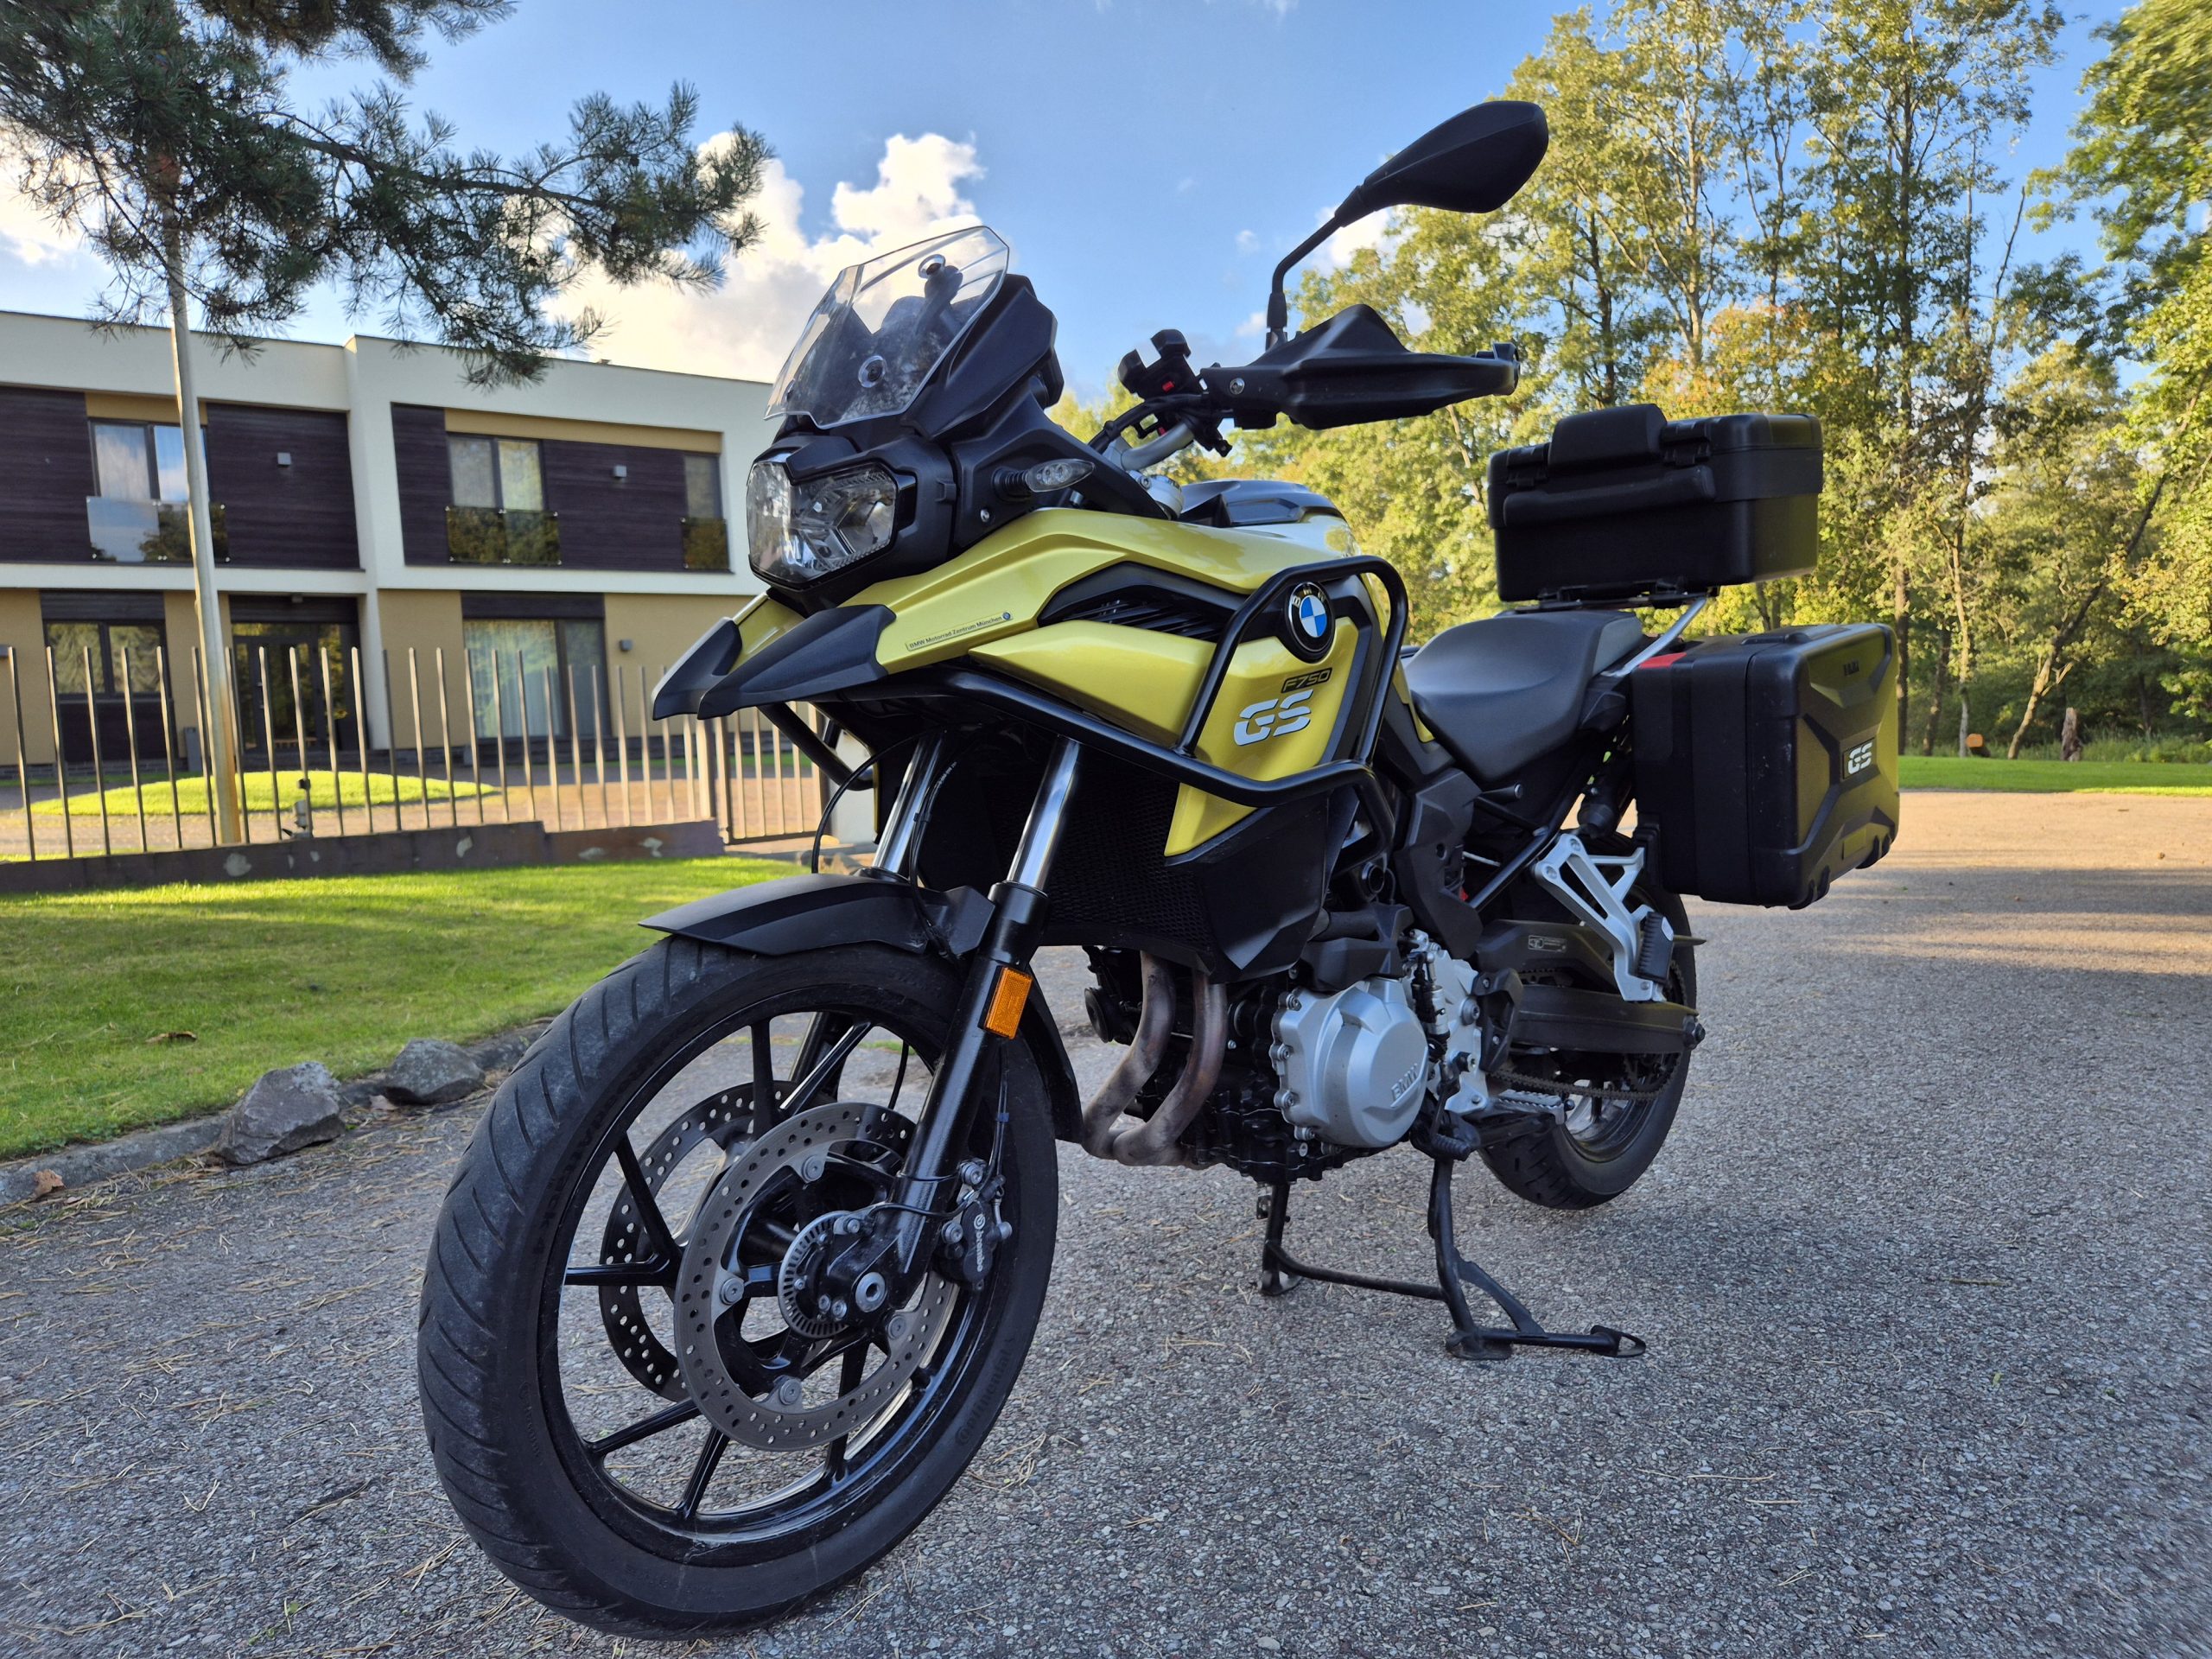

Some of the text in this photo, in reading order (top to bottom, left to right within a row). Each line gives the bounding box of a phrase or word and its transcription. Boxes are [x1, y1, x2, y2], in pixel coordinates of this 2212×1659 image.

[1292, 588, 1326, 608] BMW
[909, 616, 1002, 649] BMW Motorrad Zentrum München
[1283, 670, 1331, 690] F750
[1234, 690, 1313, 746] GS
[1848, 742, 1872, 775] GS
